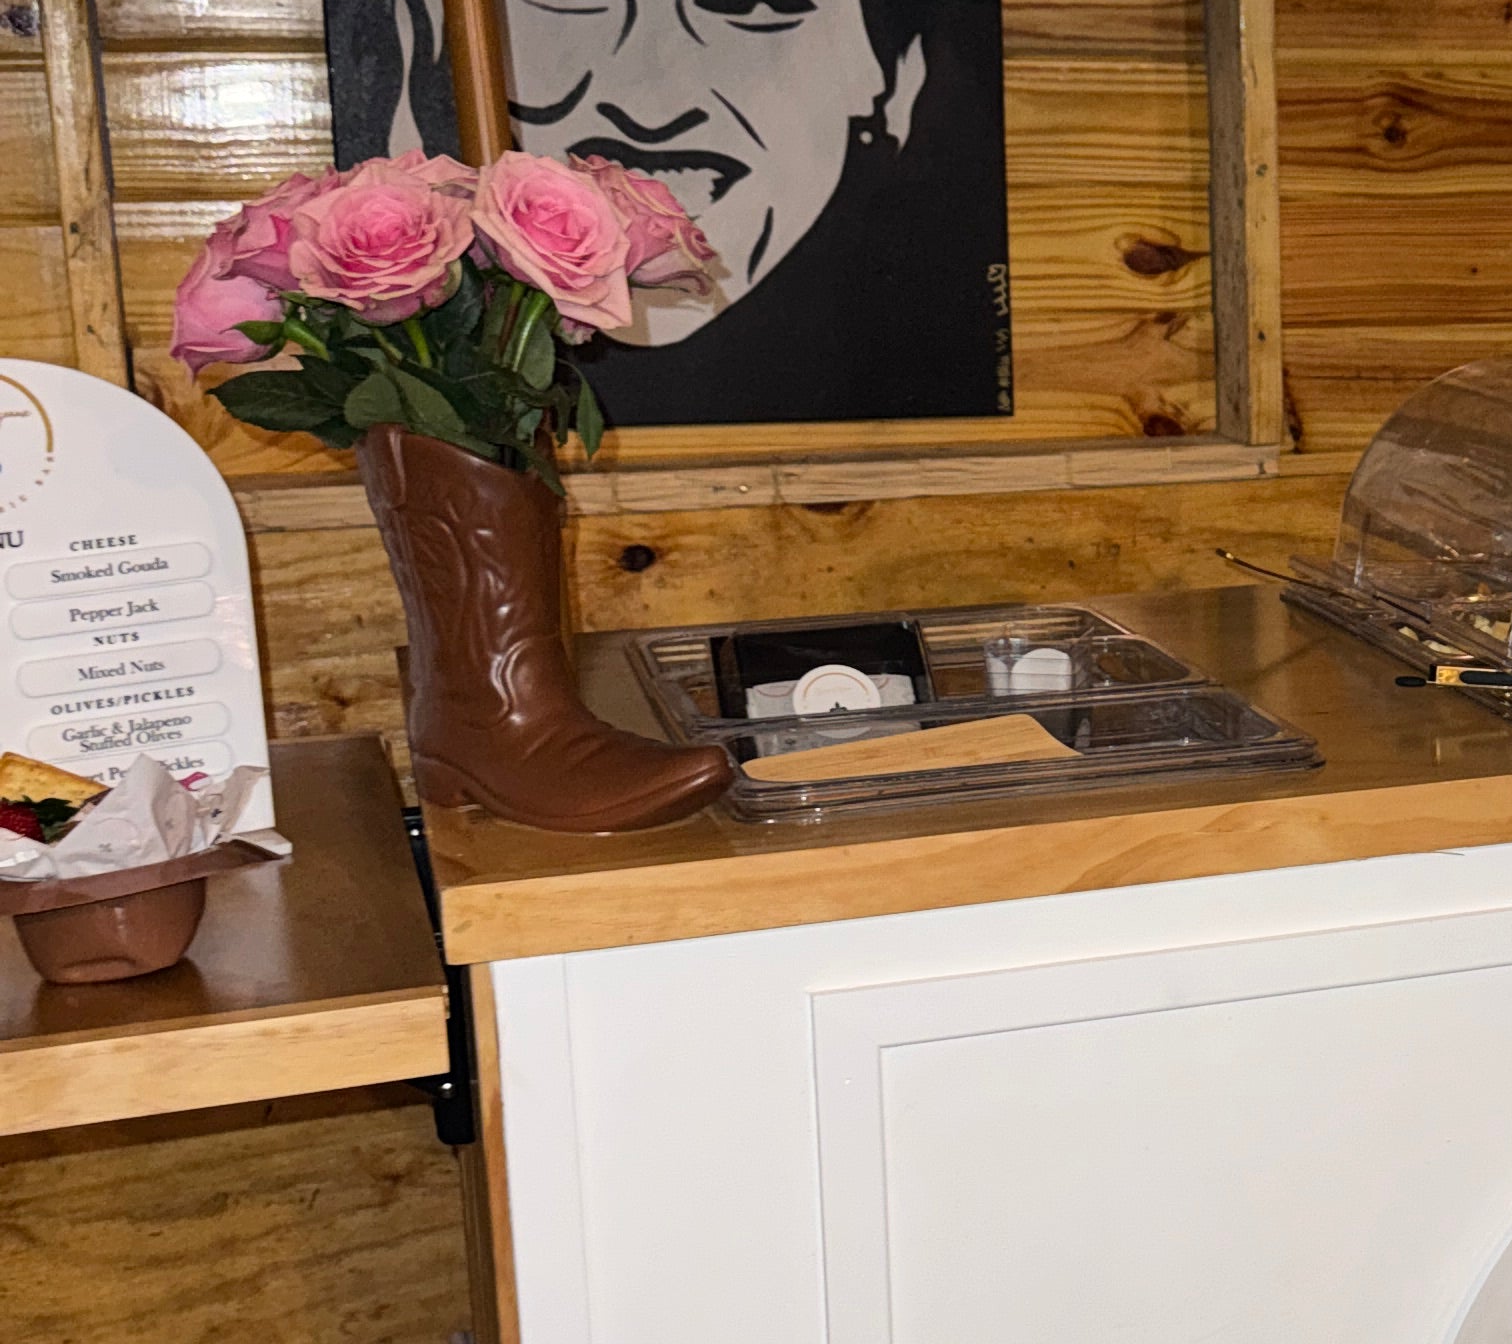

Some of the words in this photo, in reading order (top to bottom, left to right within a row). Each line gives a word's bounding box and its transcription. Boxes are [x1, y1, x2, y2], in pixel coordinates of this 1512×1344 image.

[69, 534, 139, 552] CHEESE
[50, 563, 114, 584] Smoked
[117, 557, 169, 575] Gouda
[69, 607, 123, 623] Pepper
[126, 599, 160, 617] Jack
[93, 631, 140, 647] NUTS
[78, 663, 126, 682] Mixed
[130, 660, 166, 675] Nuts
[50, 686, 196, 716] OLIVES/PICKLES
[62, 727, 108, 743] Garlic
[111, 722, 124, 735] &
[80, 733, 132, 753] Stuffed
[136, 729, 183, 745] Olives
